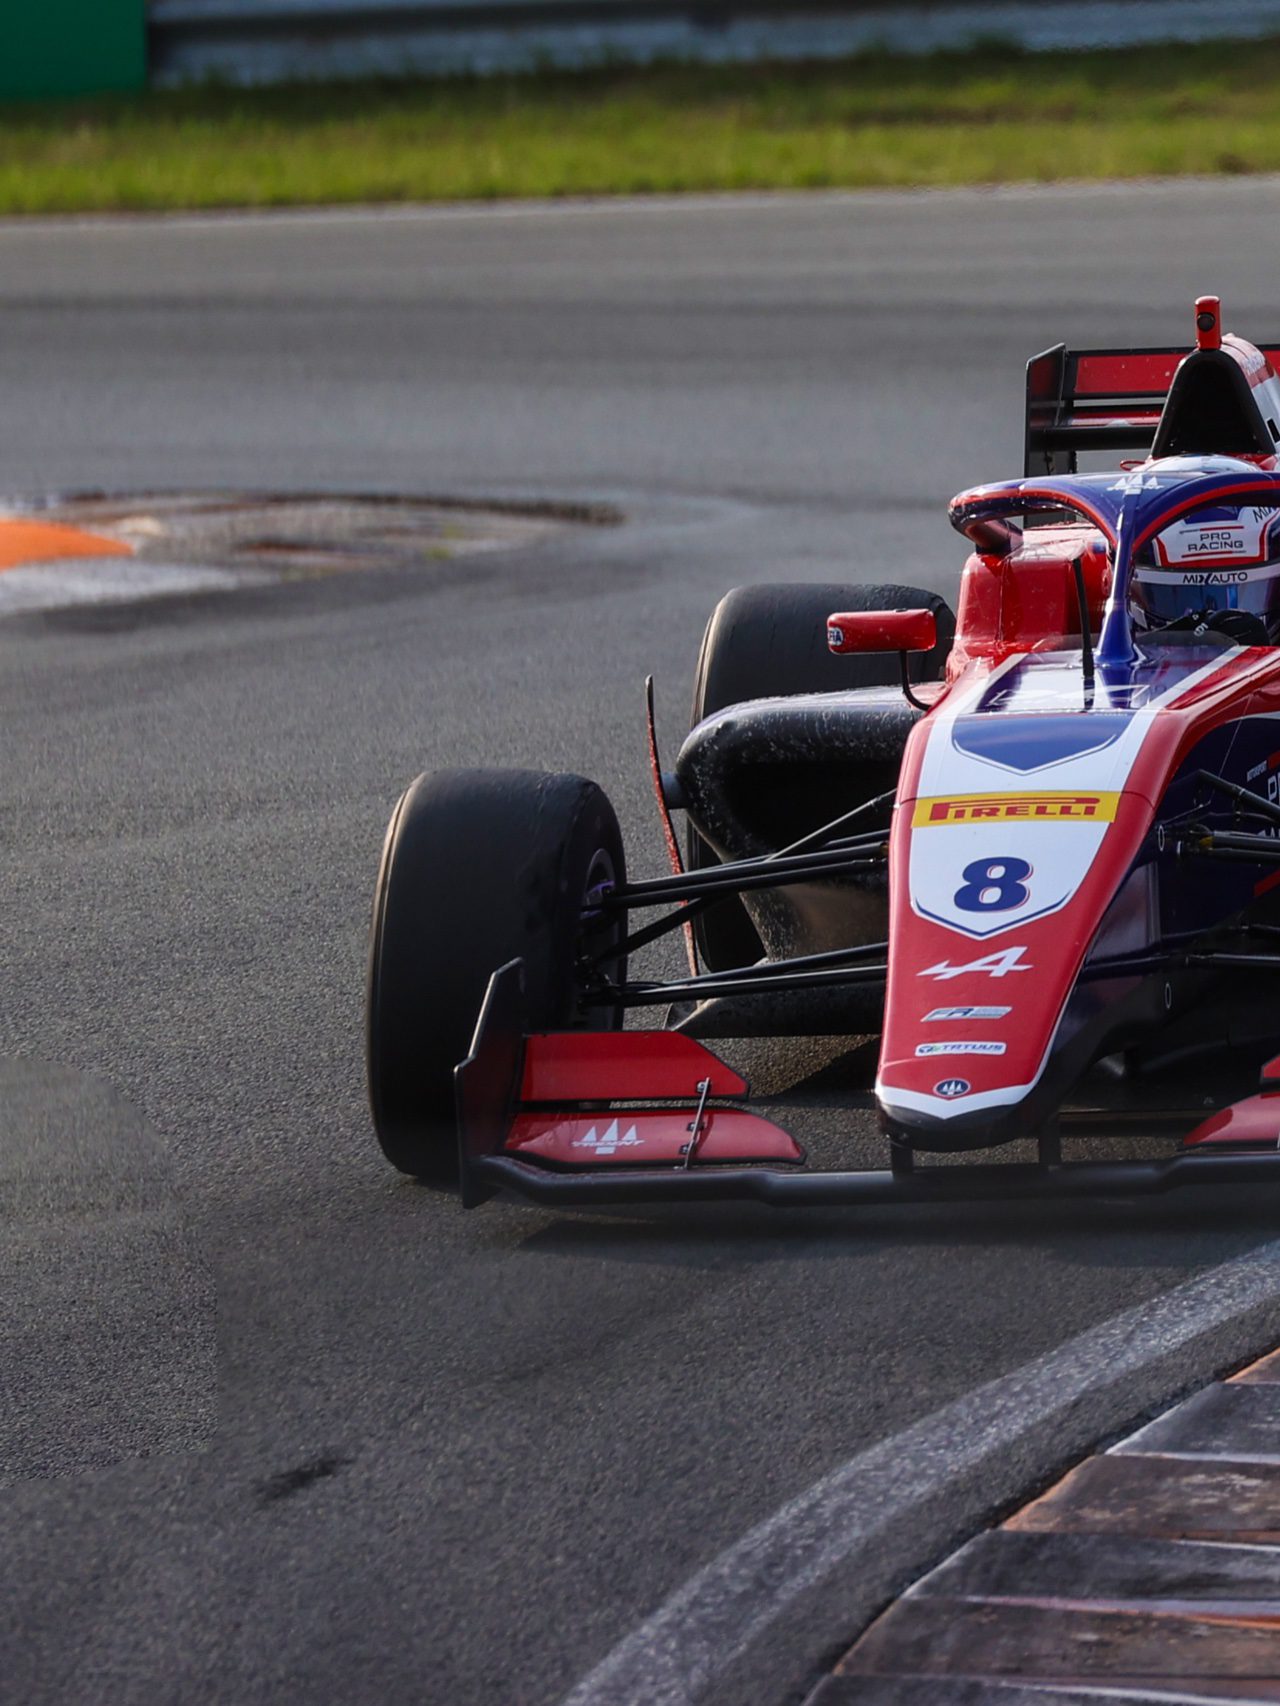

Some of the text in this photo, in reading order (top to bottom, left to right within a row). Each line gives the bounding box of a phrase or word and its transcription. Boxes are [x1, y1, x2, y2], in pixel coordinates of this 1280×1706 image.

[1200, 532, 1231, 541] PRO
[1188, 540, 1244, 551] RACING
[929, 797, 1101, 821] PIRELLI
[954, 856, 1034, 913] 8
